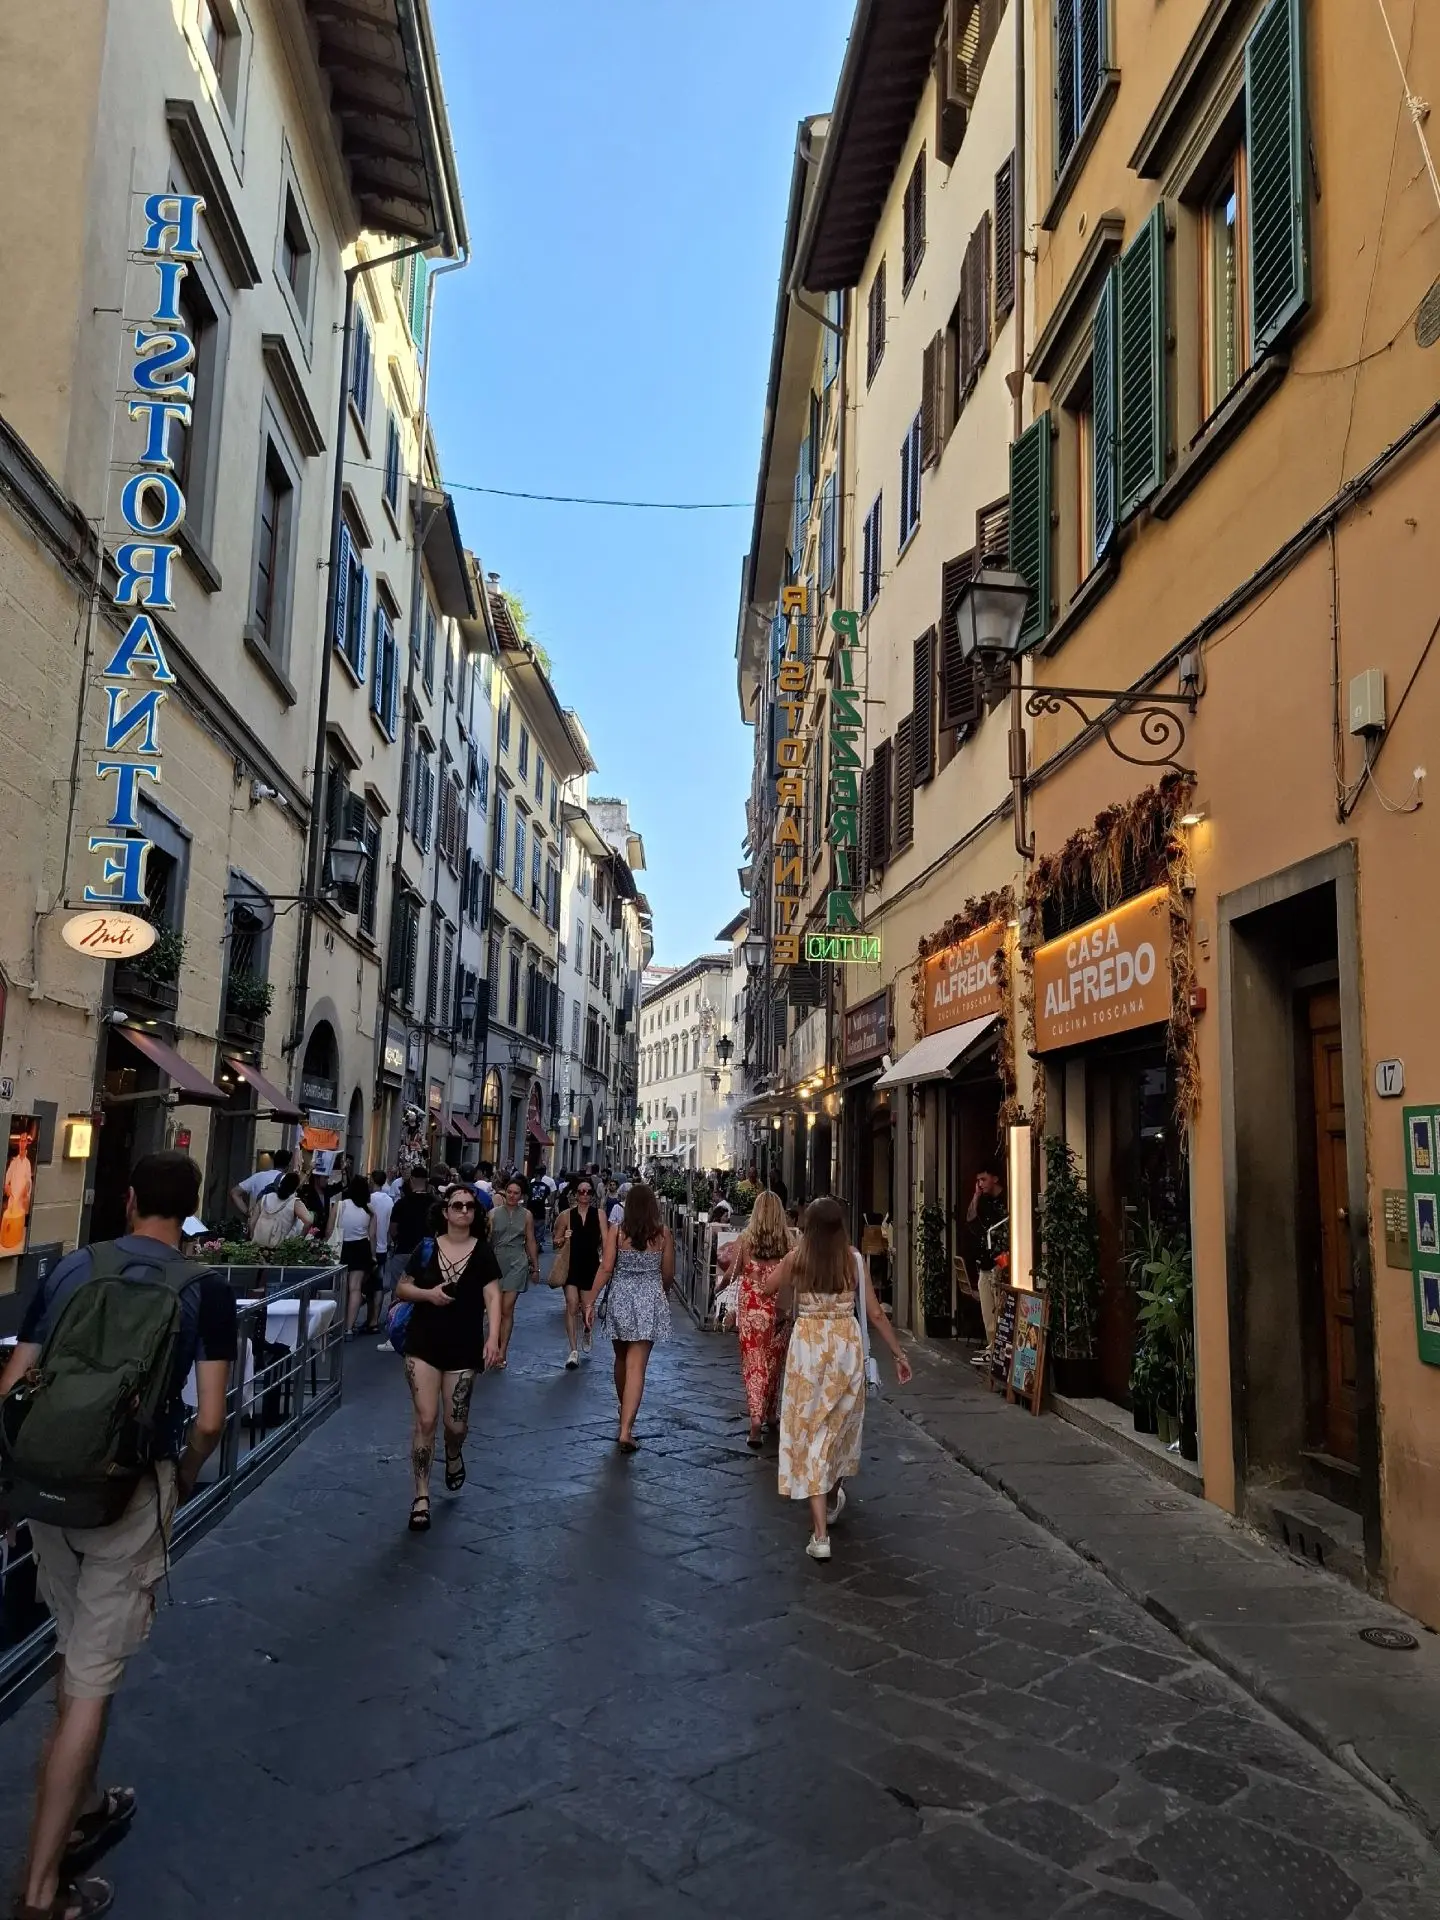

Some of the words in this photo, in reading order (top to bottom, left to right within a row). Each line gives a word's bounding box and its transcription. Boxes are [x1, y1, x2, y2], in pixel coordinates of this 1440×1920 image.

[948, 941, 979, 973] CASA
[1066, 922, 1119, 969] CASA
[1044, 942, 1156, 1018] ALFREDO
[1052, 1016, 1087, 1036] CUCINA
[1093, 998, 1144, 1024] TOSCANA
[1383, 1064, 1396, 1091] 17
